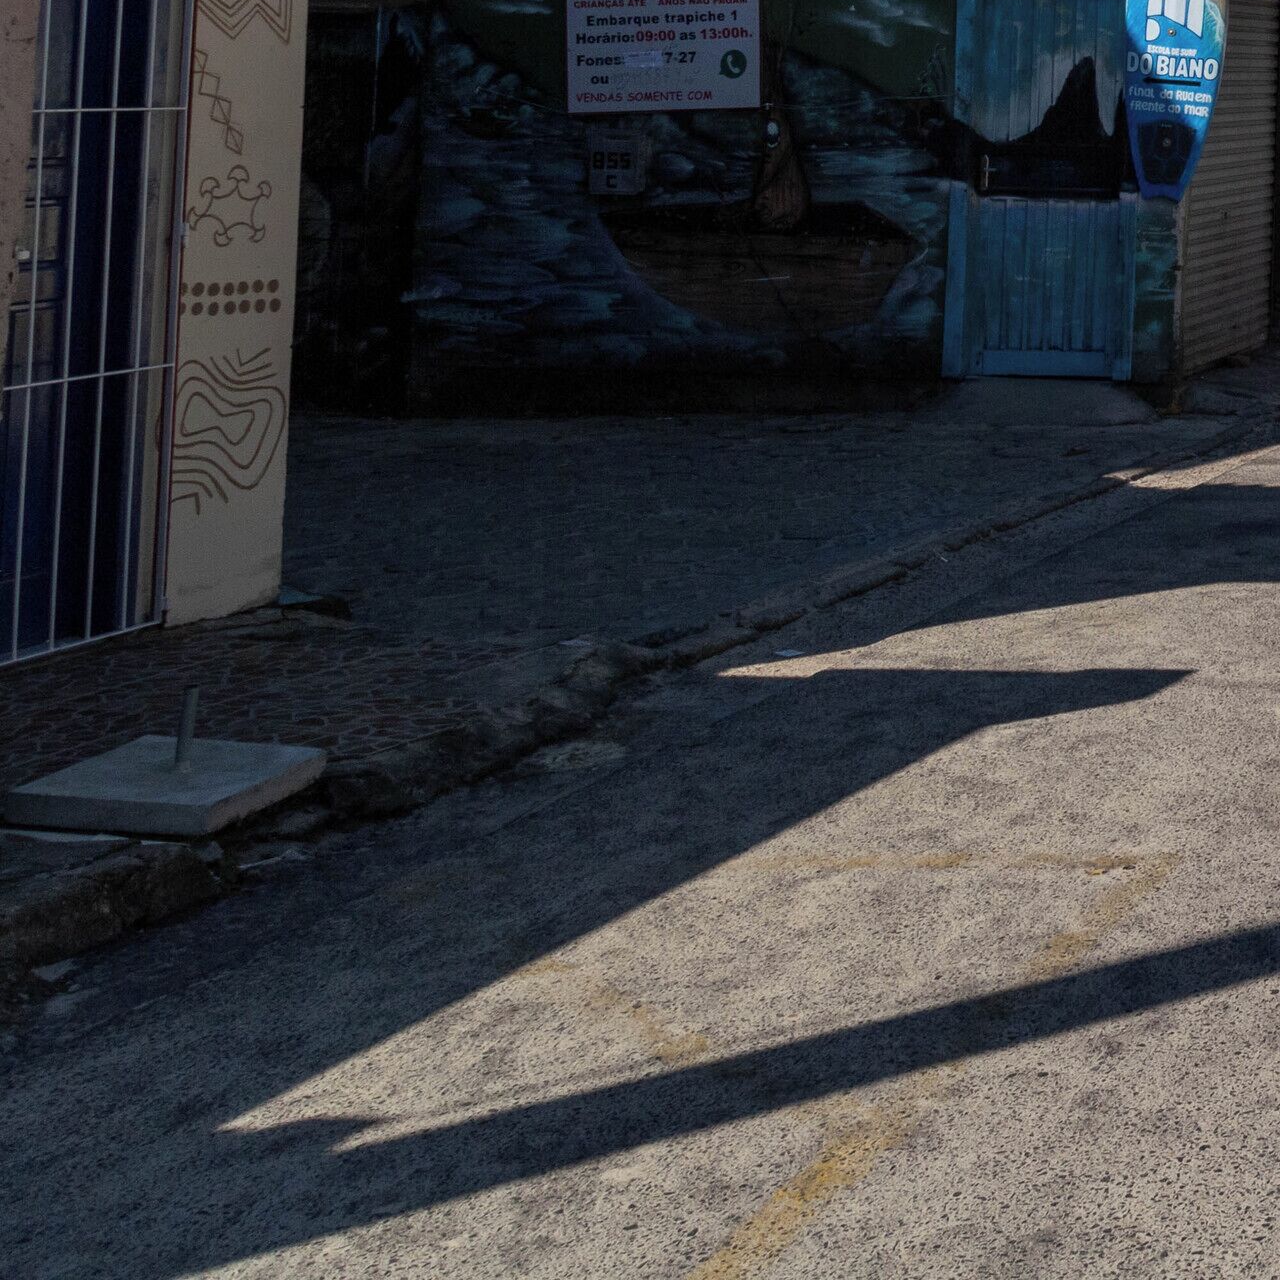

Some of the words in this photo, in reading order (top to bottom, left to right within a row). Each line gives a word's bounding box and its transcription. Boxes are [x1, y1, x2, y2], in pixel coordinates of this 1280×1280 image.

[573, 0, 625, 10] CRIANÇAS
[587, 13, 659, 27] Embarque
[664, 11, 725, 25] trapiche
[731, 10, 738, 21] 1
[679, 32, 697, 41] as
[700, 27, 752, 40] 13:00h.
[1127, 51, 1153, 75] DO
[1156, 55, 1219, 80] BIANO
[590, 74, 610, 85] ou
[575, 92, 624, 103] VENDAS
[627, 91, 683, 103] SOMENTE
[688, 90, 713, 100] COM
[1160, 89, 1173, 99] da
